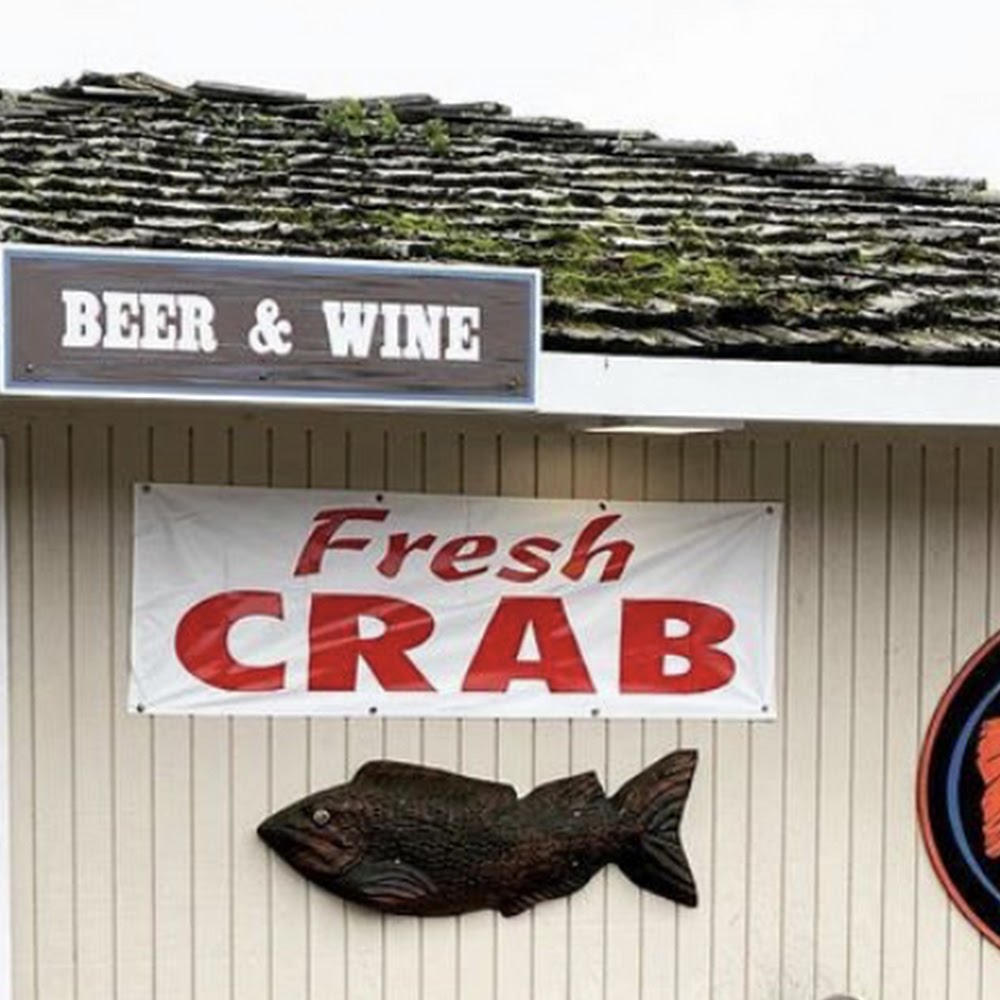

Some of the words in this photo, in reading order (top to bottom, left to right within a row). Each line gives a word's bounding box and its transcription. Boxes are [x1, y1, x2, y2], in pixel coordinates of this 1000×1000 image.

[61, 289, 218, 353] BEER
[248, 298, 293, 355] &
[321, 300, 481, 362] WINE
[293, 506, 635, 583] Fresh
[174, 590, 737, 696] CRAB
